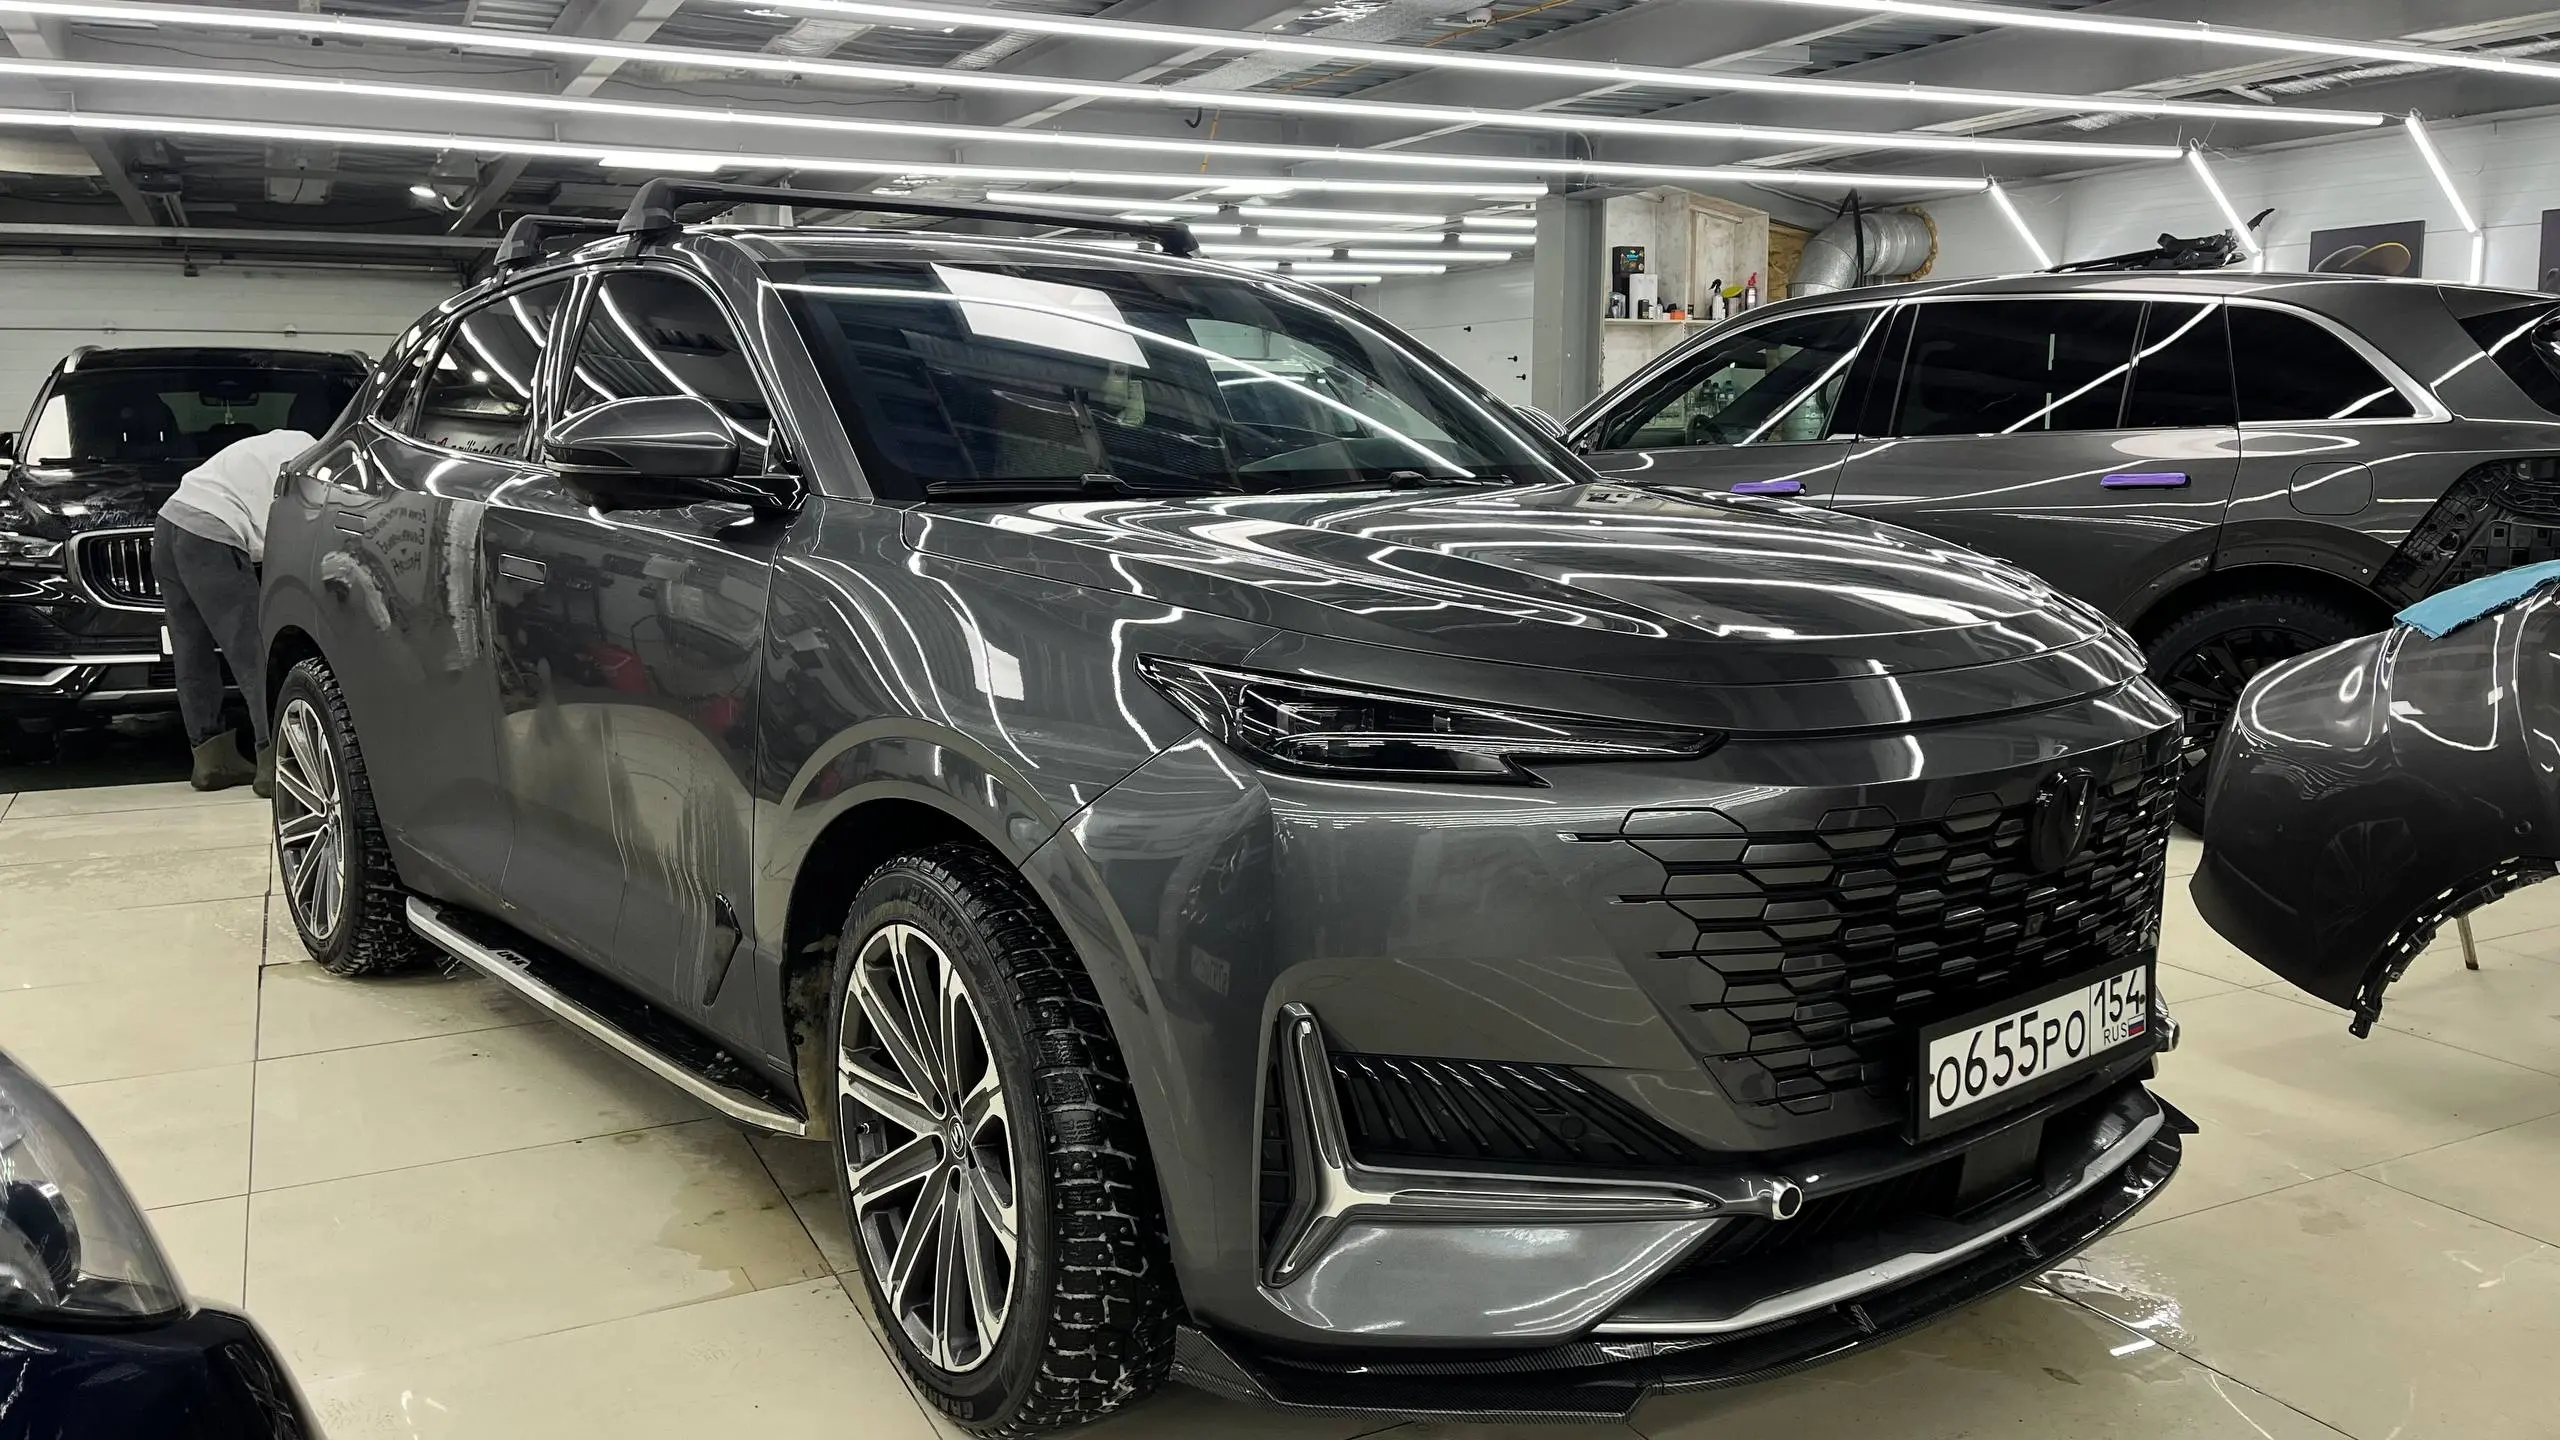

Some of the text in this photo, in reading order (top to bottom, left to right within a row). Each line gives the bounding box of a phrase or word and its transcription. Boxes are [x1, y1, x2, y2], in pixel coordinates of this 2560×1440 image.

[1937, 970, 2140, 1107] O655PO 154
[2103, 1022, 2127, 1046] RUS
